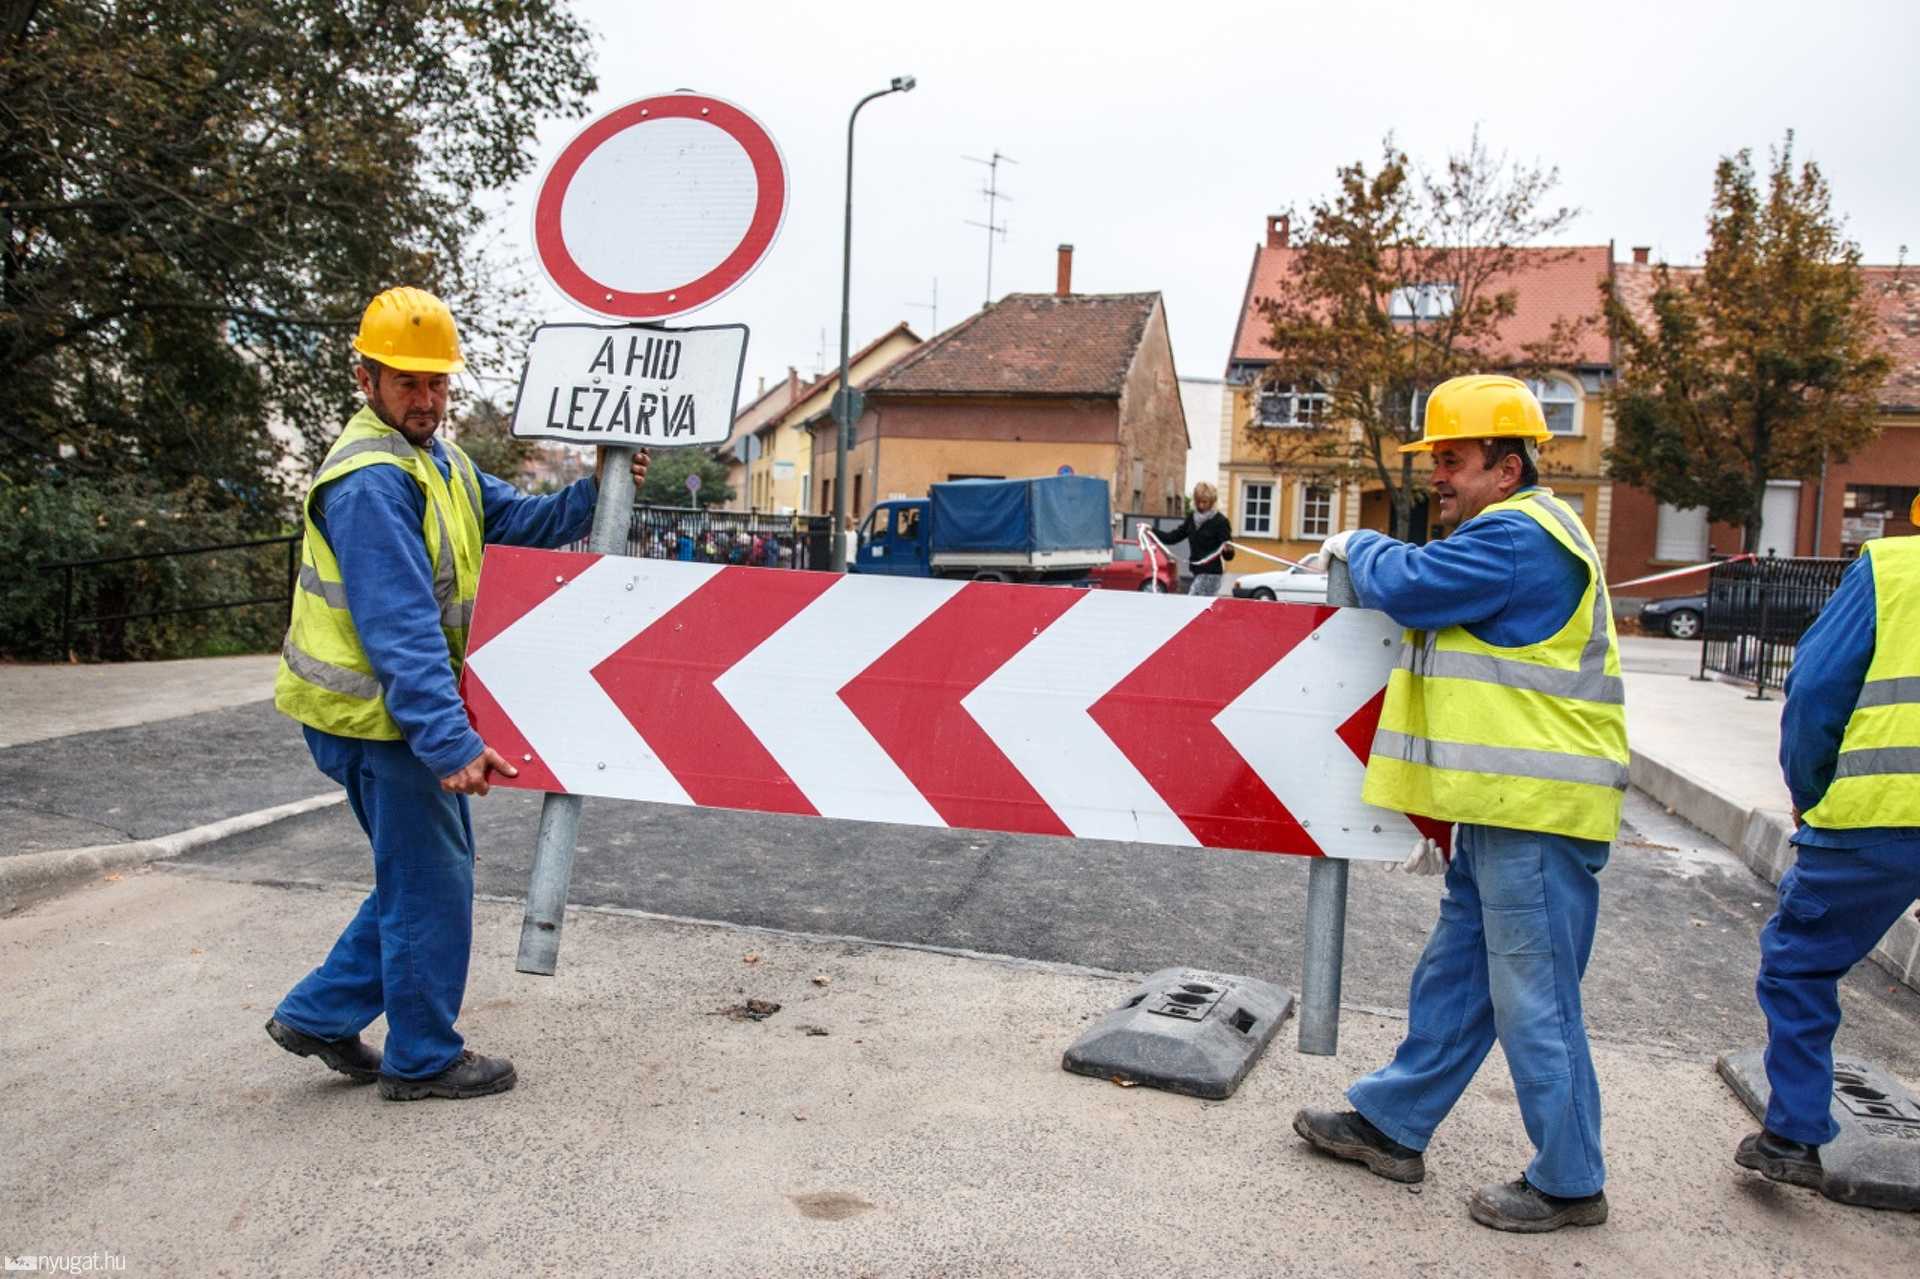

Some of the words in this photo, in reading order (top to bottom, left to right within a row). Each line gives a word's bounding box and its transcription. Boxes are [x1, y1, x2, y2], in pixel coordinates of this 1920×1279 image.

[588, 336, 614, 374] A
[624, 336, 682, 380] HID
[546, 385, 696, 437] LEZÁRVA
